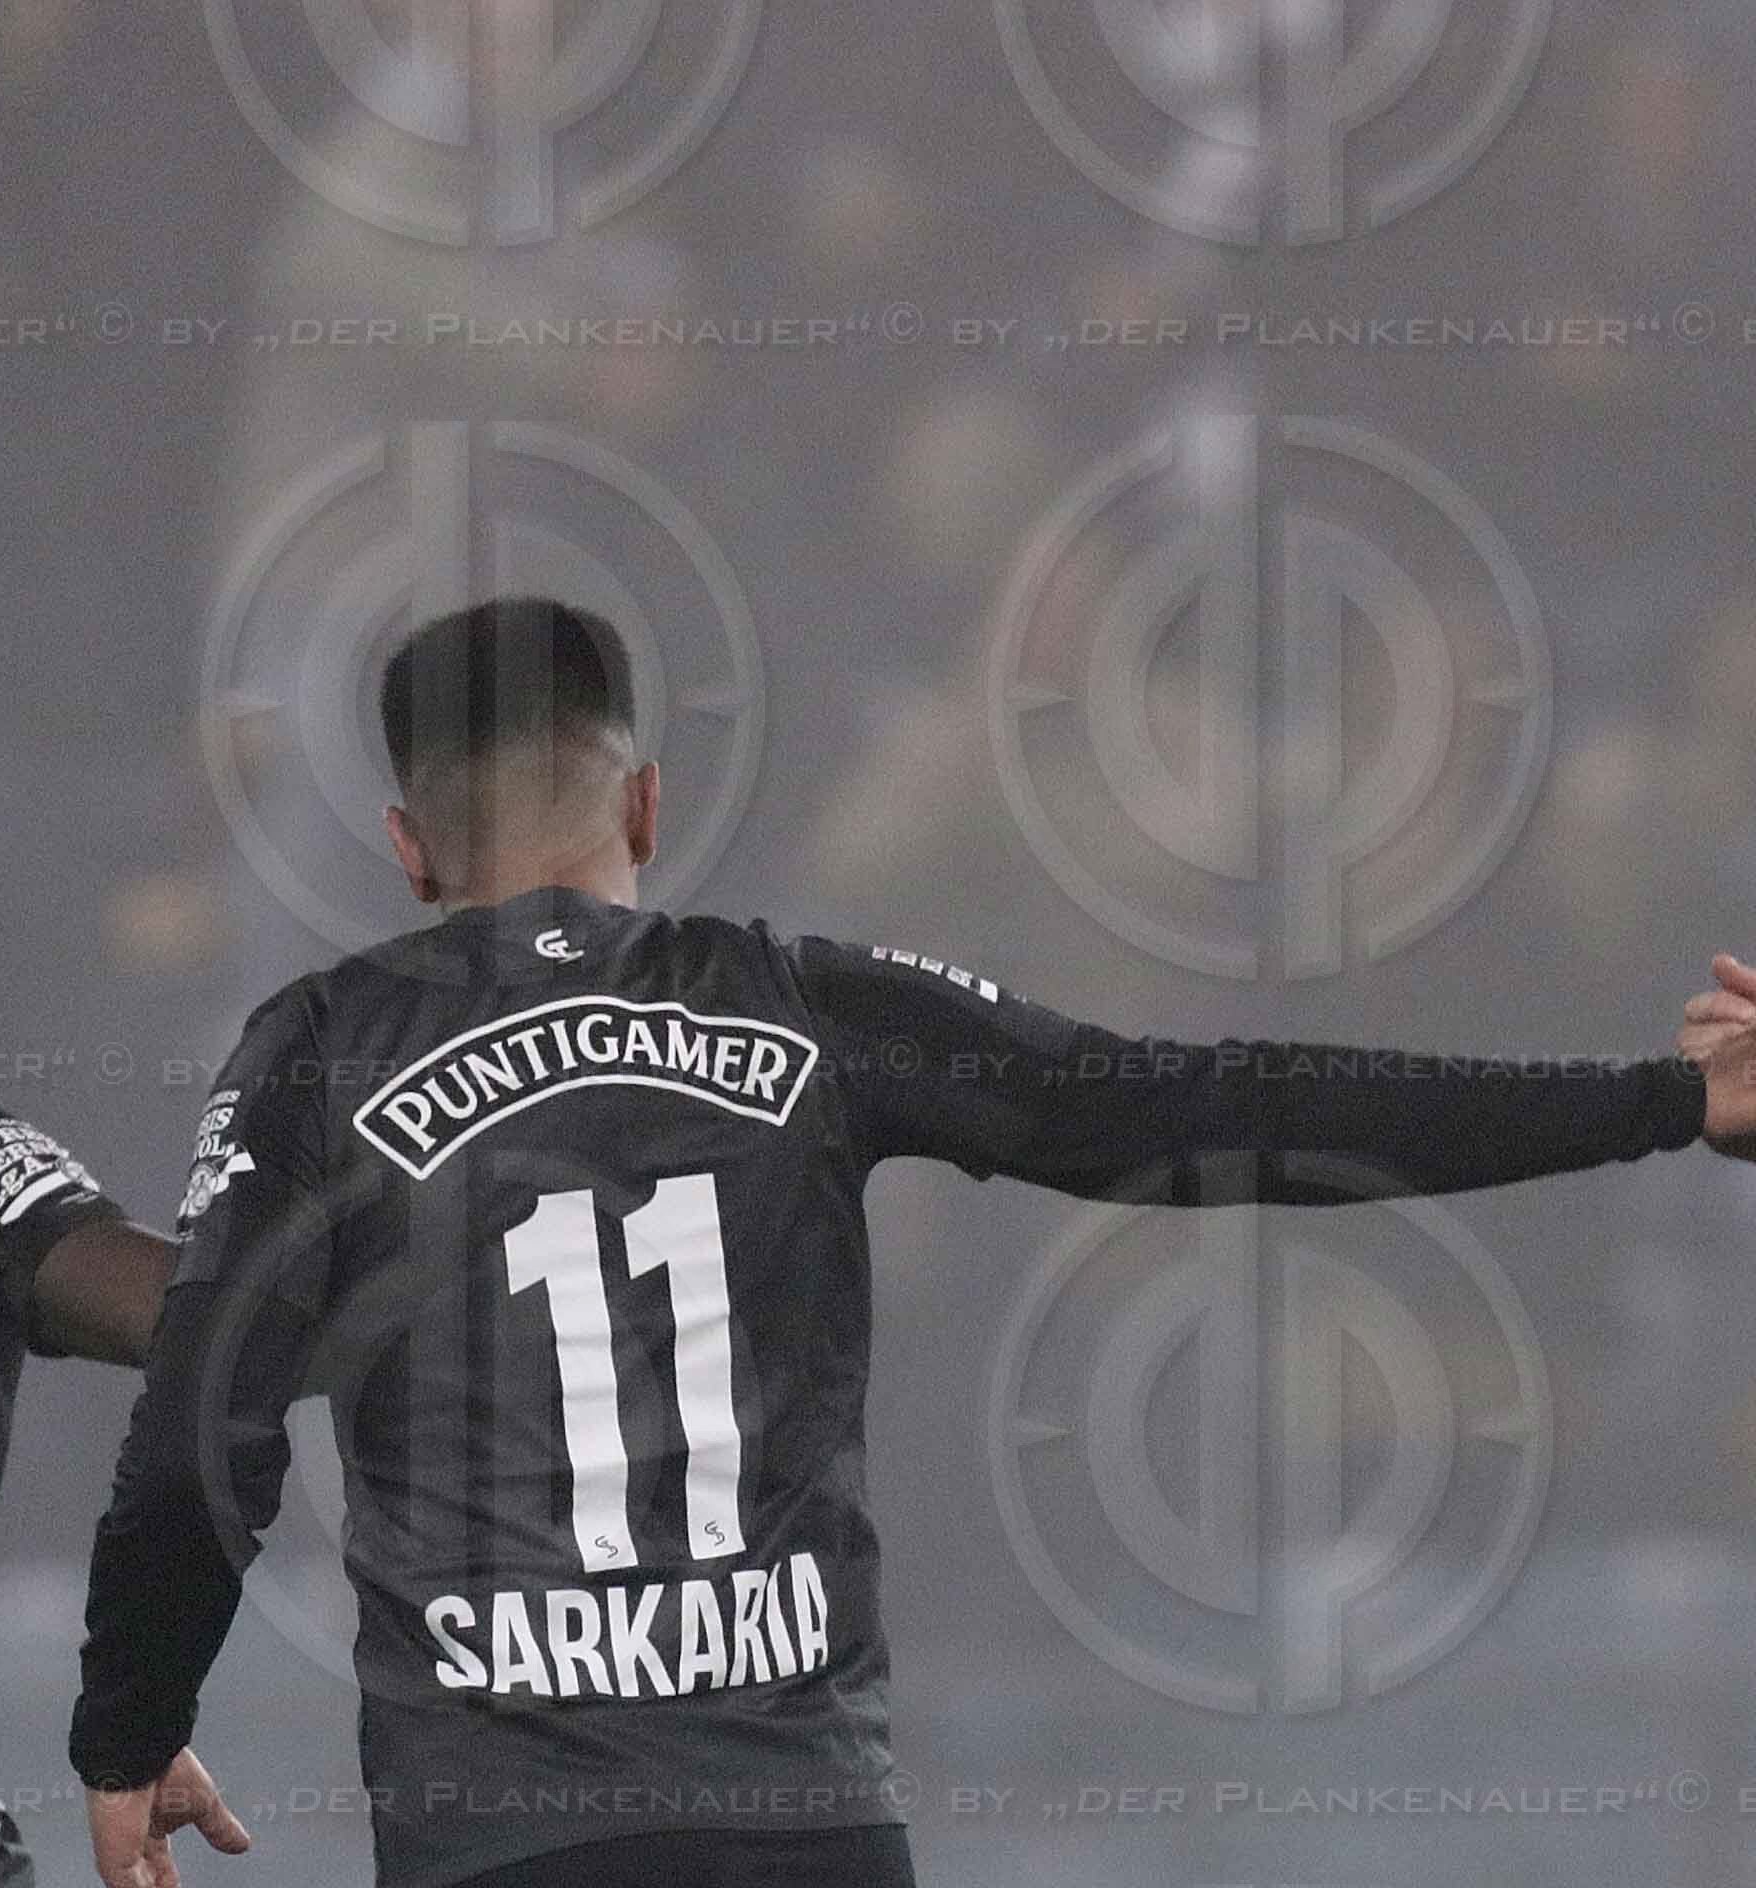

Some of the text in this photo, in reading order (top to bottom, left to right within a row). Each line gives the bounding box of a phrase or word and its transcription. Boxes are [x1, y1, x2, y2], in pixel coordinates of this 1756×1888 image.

[381, 1012, 789, 1152] PUNTIGAMER
[503, 1172, 748, 1573] 11
[424, 1552, 829, 1698] SARKARIA
